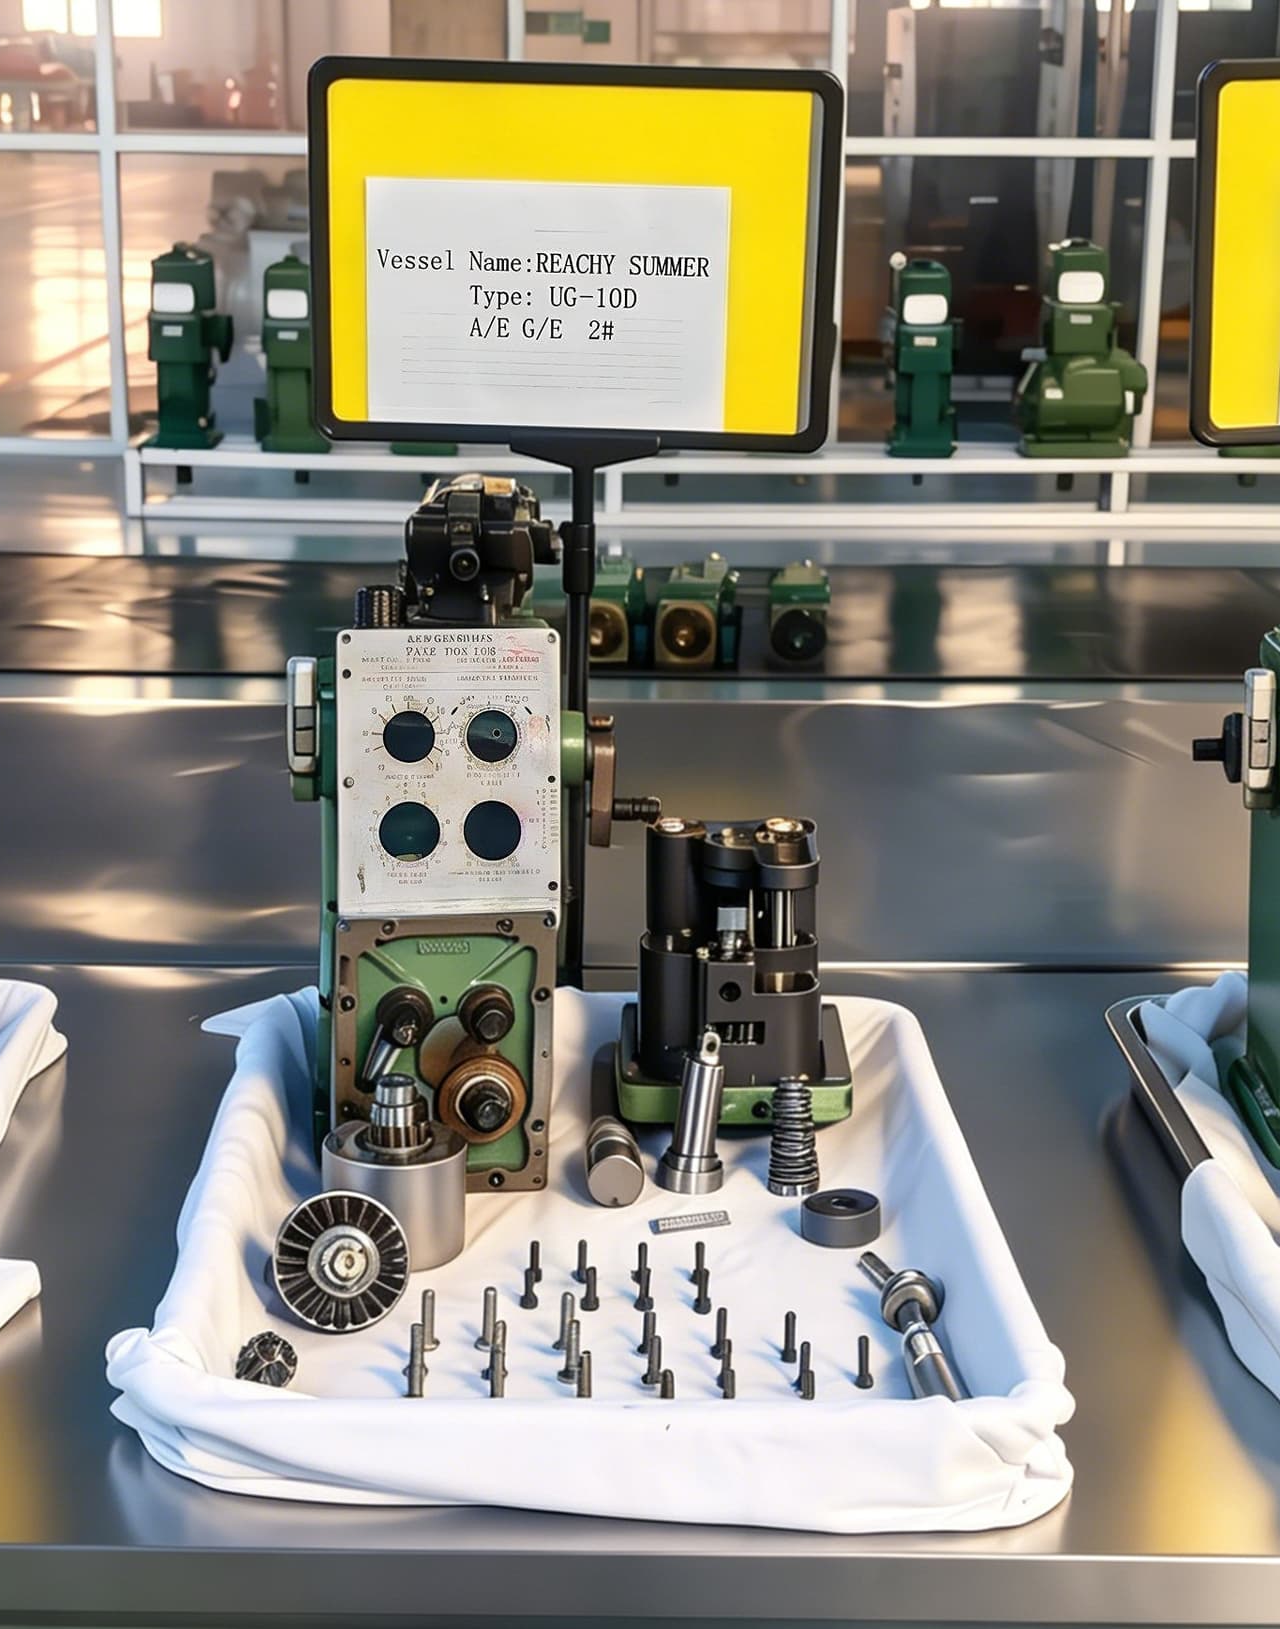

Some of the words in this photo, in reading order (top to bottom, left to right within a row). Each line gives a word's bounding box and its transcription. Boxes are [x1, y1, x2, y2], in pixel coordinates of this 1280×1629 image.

[376, 248, 455, 271] Vessel
[468, 250, 616, 275] Name:REACHY
[628, 254, 710, 278] SUMMER
[468, 284, 532, 311] Type:
[549, 285, 638, 309] UG-10D
[468, 315, 510, 339] A/E
[521, 316, 563, 341] G/E
[588, 319, 615, 341] 2#
